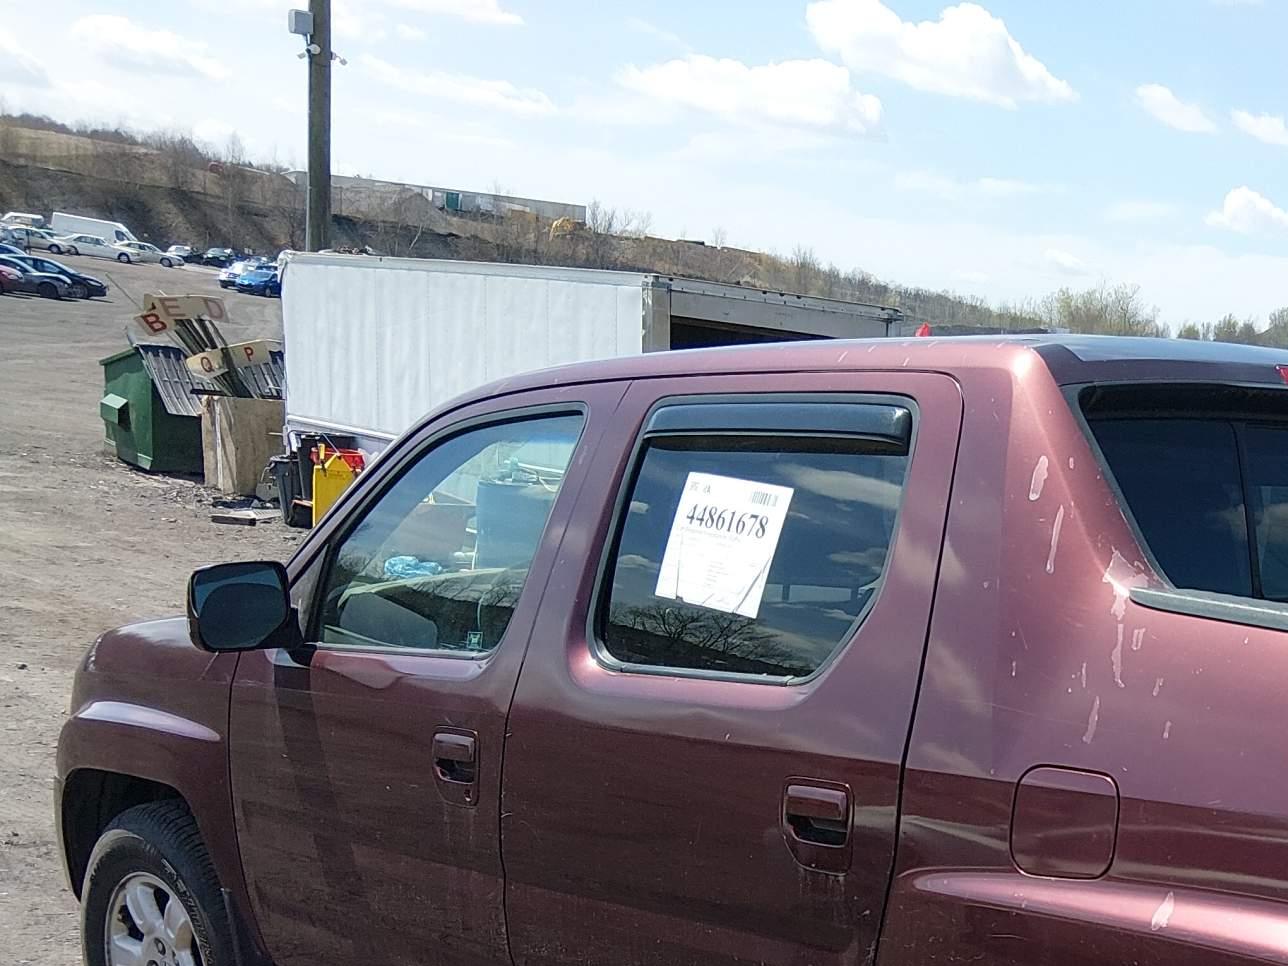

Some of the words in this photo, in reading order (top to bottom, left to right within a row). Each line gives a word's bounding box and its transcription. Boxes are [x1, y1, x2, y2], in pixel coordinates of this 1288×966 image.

[158, 298, 186, 317] E
[142, 313, 167, 333] B
[243, 346, 254, 362] P
[200, 356, 215, 374] Q
[686, 503, 769, 539] 44861678
